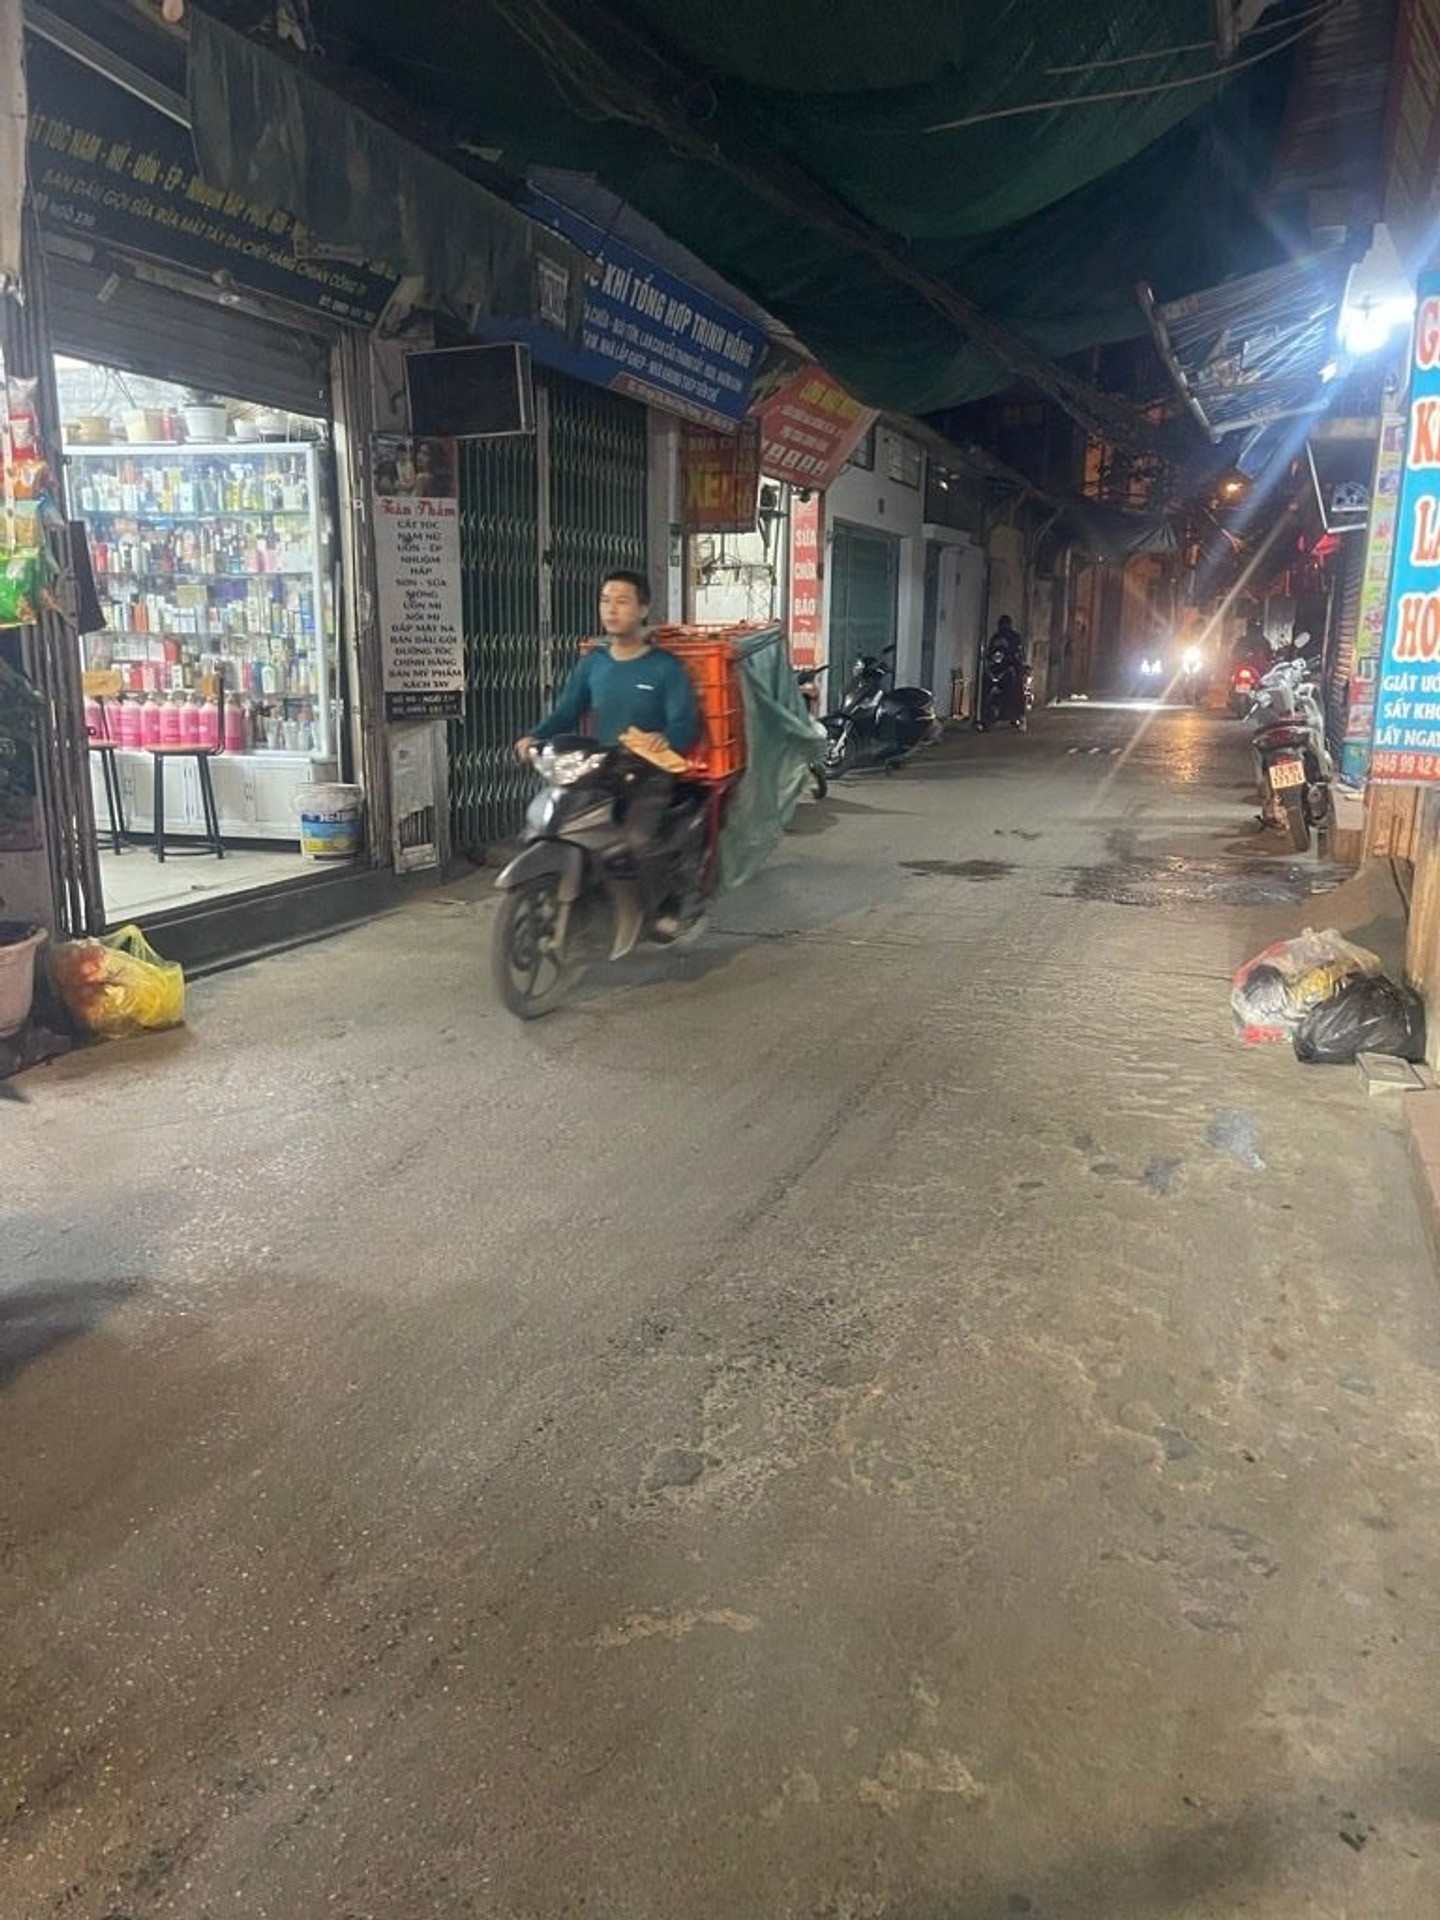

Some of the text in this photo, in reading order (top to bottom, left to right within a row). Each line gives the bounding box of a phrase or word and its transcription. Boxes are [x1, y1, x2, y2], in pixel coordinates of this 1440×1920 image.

[1383, 671, 1419, 696] GIẶT
[1383, 697, 1412, 720] SẤY
[1375, 723, 1403, 746] LẤY
